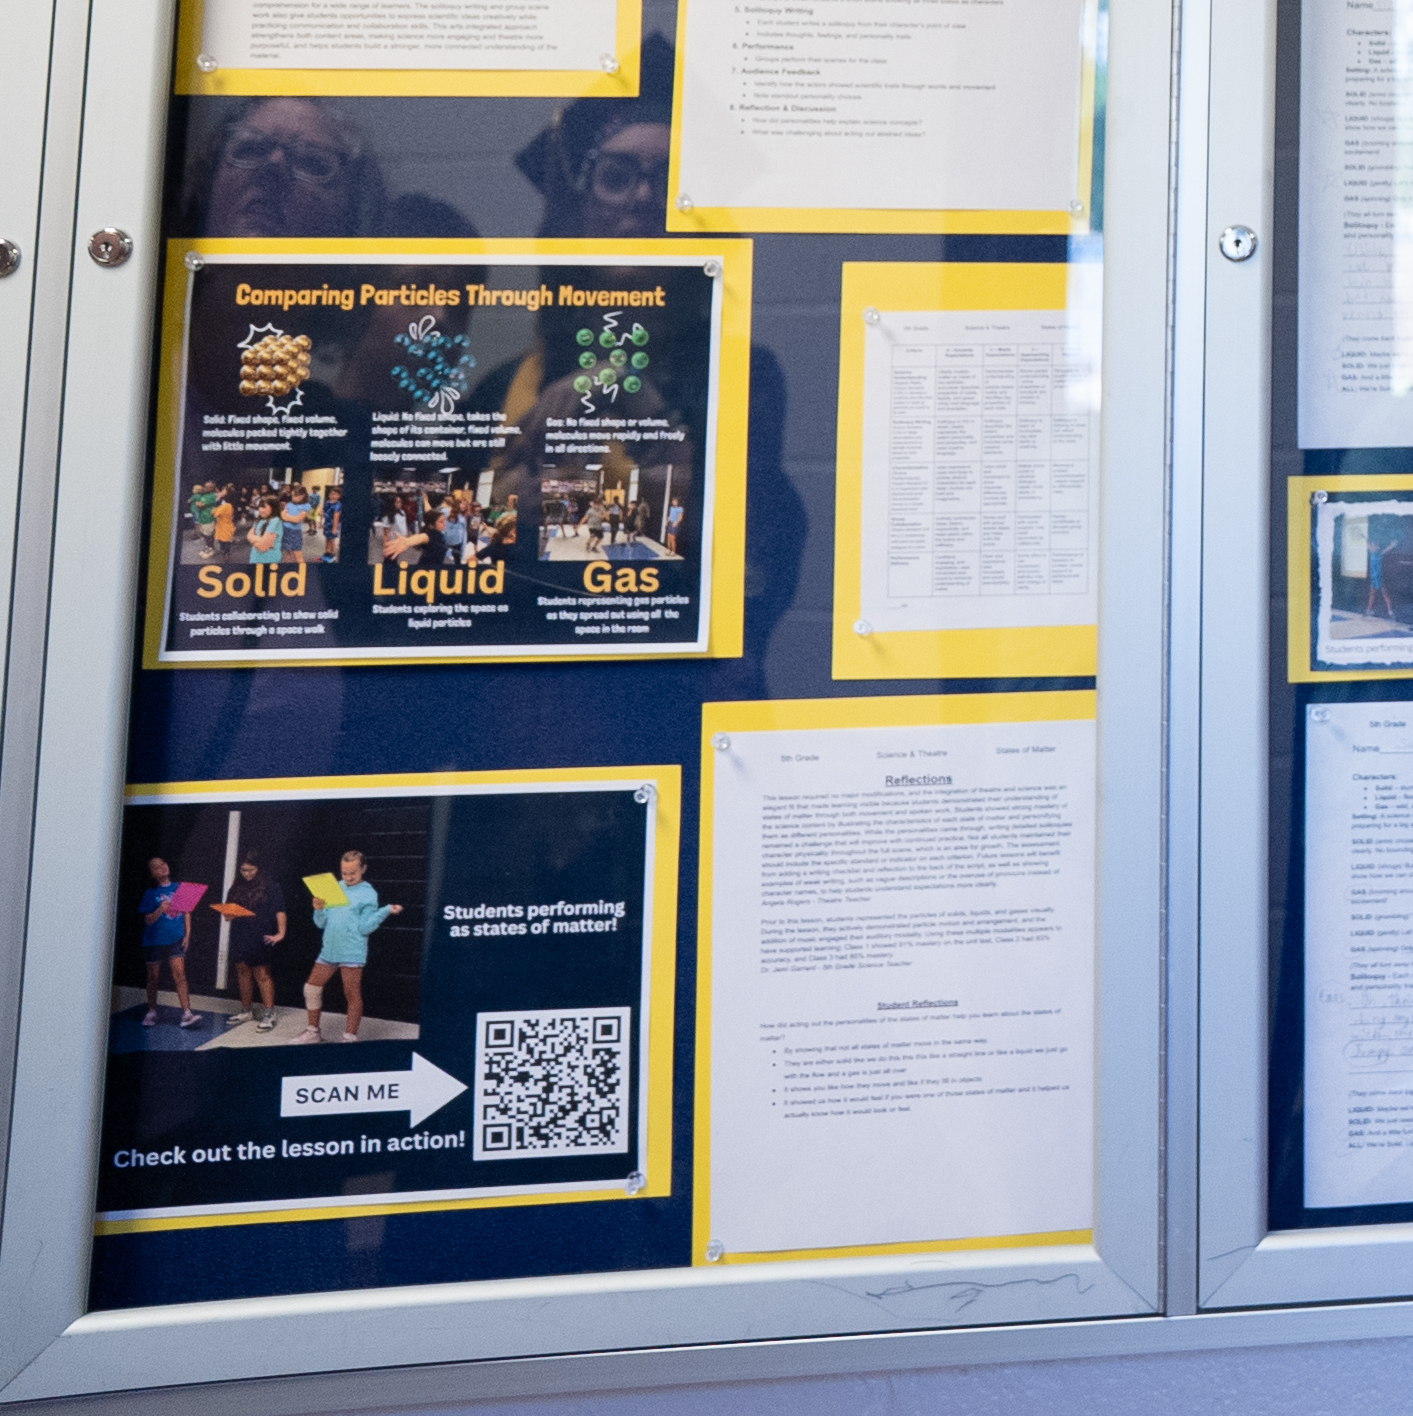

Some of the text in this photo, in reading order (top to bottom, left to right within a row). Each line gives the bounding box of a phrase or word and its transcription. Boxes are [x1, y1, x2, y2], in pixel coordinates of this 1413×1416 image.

[235, 283, 665, 311] Comparing Particles Through Movement
[251, 413, 281, 425] shape,
[401, 411, 414, 421] No
[437, 410, 465, 422] shape,
[466, 411, 491, 421] takes
[491, 410, 508, 424] the
[565, 417, 577, 427] No
[600, 417, 626, 428] shape
[202, 427, 346, 439] molecules packed tightly together
[371, 425, 398, 436] shape
[408, 424, 423, 435] its
[422, 424, 467, 434] container,
[545, 429, 684, 441] molecules move rapidly and freely
[201, 440, 292, 451] with little movement.
[370, 437, 413, 448] molecules
[414, 439, 431, 448] can
[430, 439, 454, 448] move
[455, 438, 471, 447] but
[488, 437, 505, 447] still
[544, 443, 612, 453] in all directions.
[400, 451, 449, 461] connected.
[198, 561, 306, 598] Solid
[373, 559, 504, 603] Liquid
[583, 559, 658, 593] Gas
[537, 594, 689, 607] Students representing gas particles
[179, 608, 339, 621] Students collaborating to show solid
[372, 603, 412, 614] Students
[413, 601, 453, 615] exploring
[454, 602, 468, 613] the
[470, 604, 496, 614] space
[558, 609, 578, 621] they
[578, 610, 610, 621] spread
[609, 609, 625, 619] out
[626, 609, 650, 621] using
[650, 608, 661, 619] all
[664, 608, 679, 619] the
[407, 617, 471, 629] liquid particles
[574, 623, 649, 635] space in the room
[189, 625, 230, 636] particles
[232, 624, 267, 637] through
[276, 625, 303, 635] space
[304, 623, 324, 634] walk
[884, 774, 952, 786] Reflections
[443, 899, 625, 921] Students performing
[449, 917, 617, 937] as states of matter!
[877, 998, 958, 1010] Student Reflections
[295, 1083, 398, 1104] SCAN ME
[113, 1129, 465, 1168] Check out the lesson in action!
